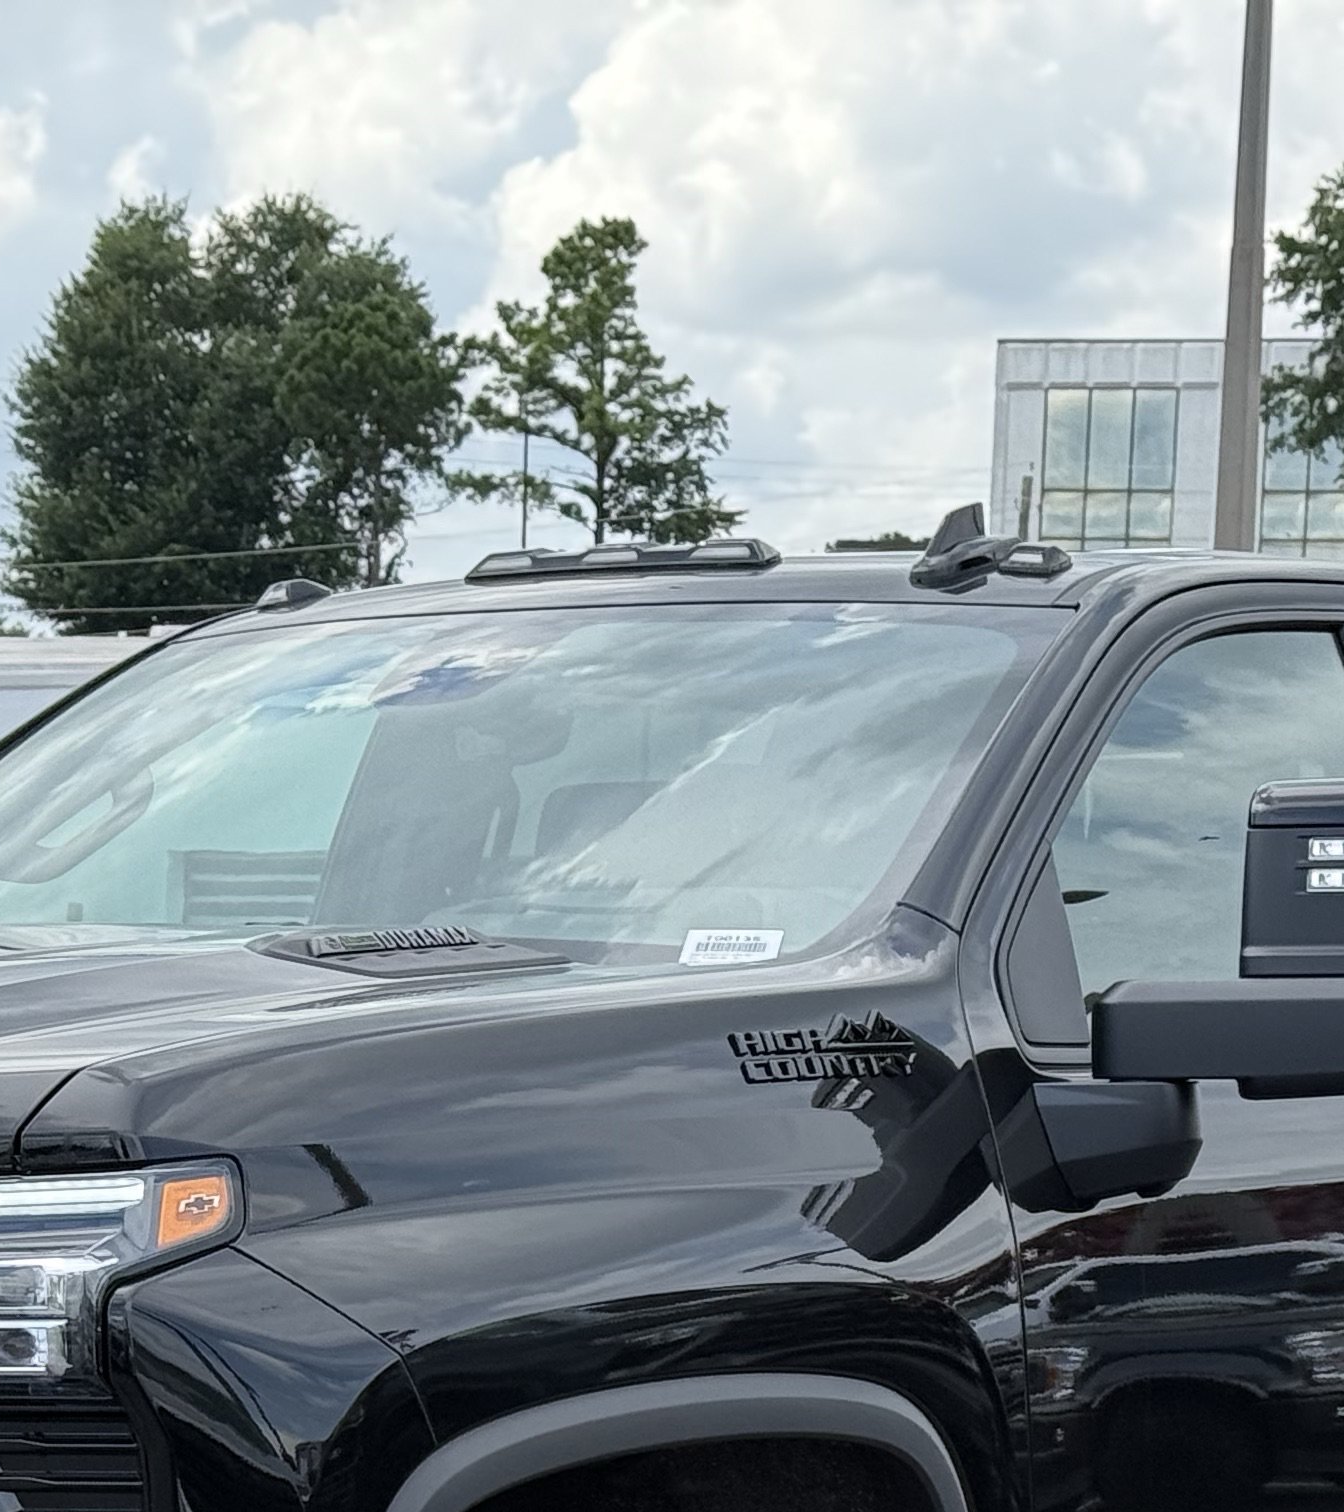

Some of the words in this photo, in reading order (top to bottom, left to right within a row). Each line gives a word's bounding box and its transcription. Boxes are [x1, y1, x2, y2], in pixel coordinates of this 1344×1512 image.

[374, 925, 479, 950] DURAMAX
[727, 1029, 829, 1057] HIGH
[740, 1052, 917, 1084] COUNTRY
